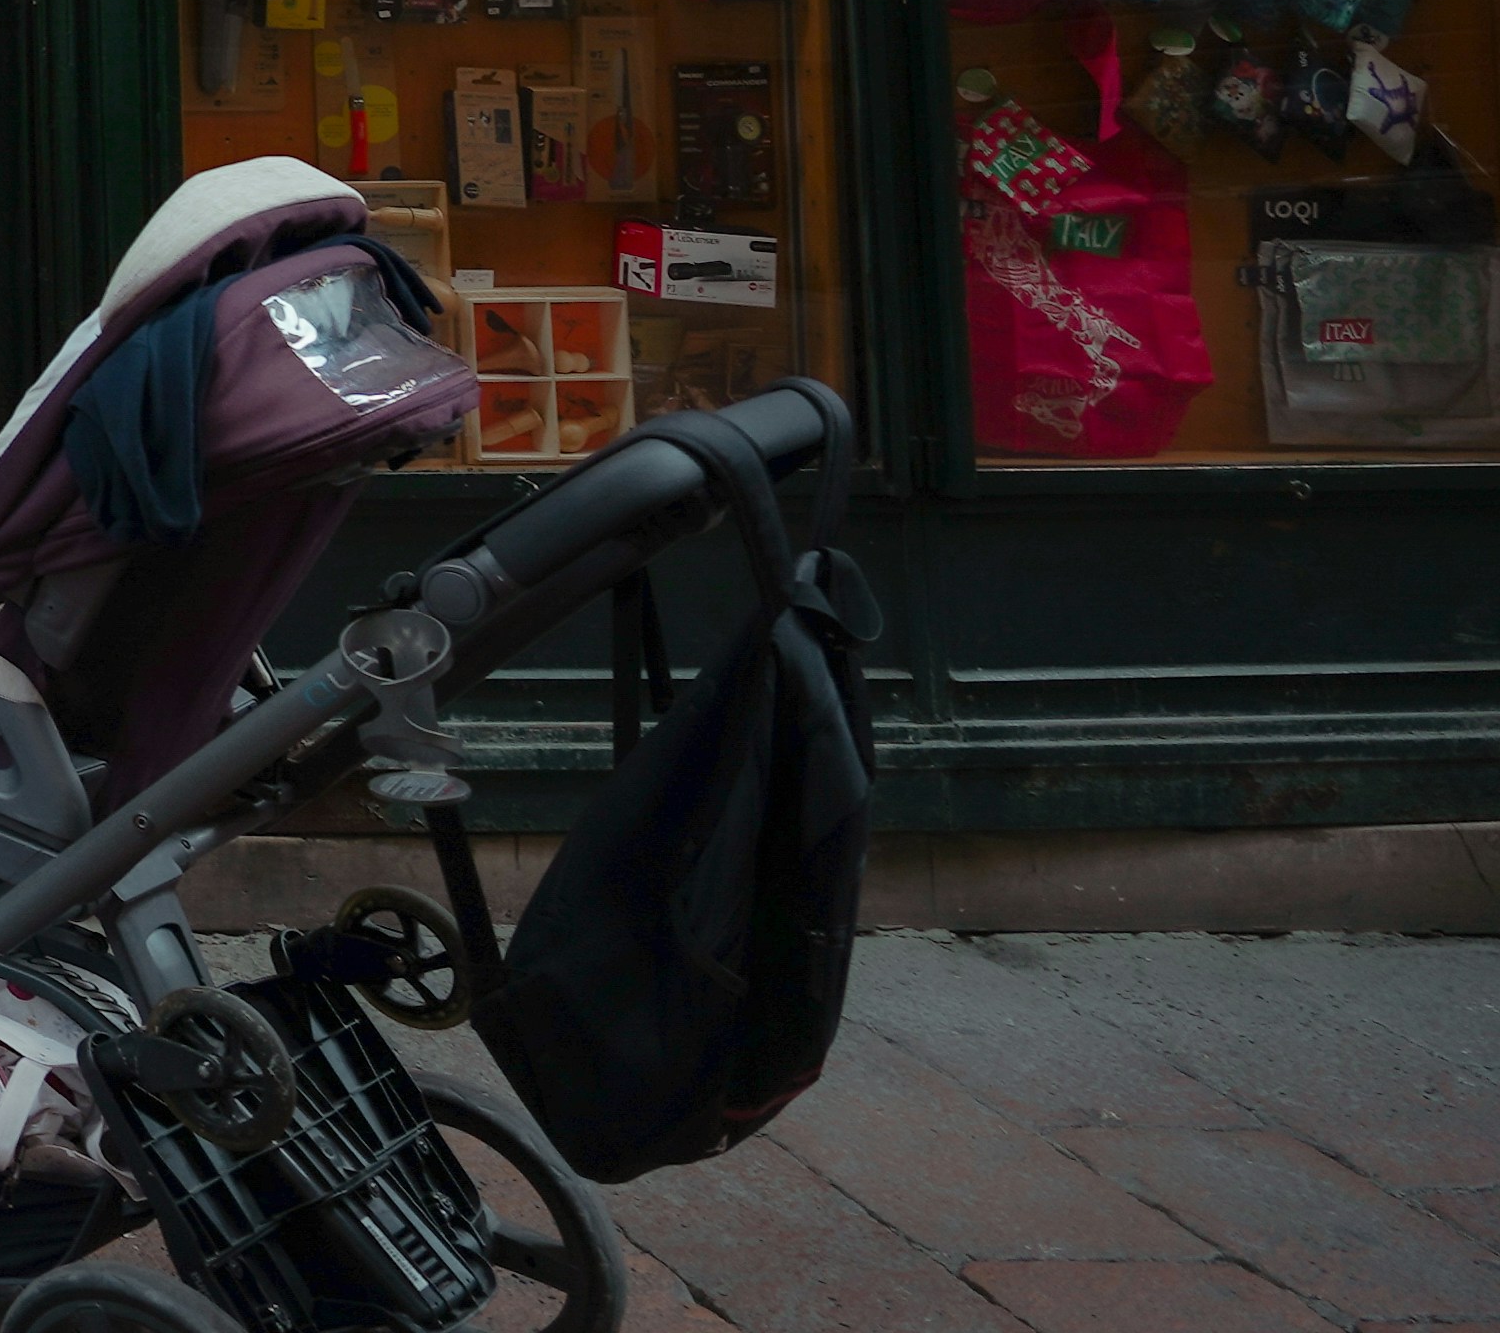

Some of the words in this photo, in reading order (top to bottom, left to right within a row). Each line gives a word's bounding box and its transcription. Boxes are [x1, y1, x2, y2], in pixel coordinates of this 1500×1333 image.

[993, 134, 1038, 179] ITALY
[1264, 200, 1320, 225] LOQI
[1062, 214, 1124, 250] ITALY
[1325, 321, 1372, 342] ITALY
